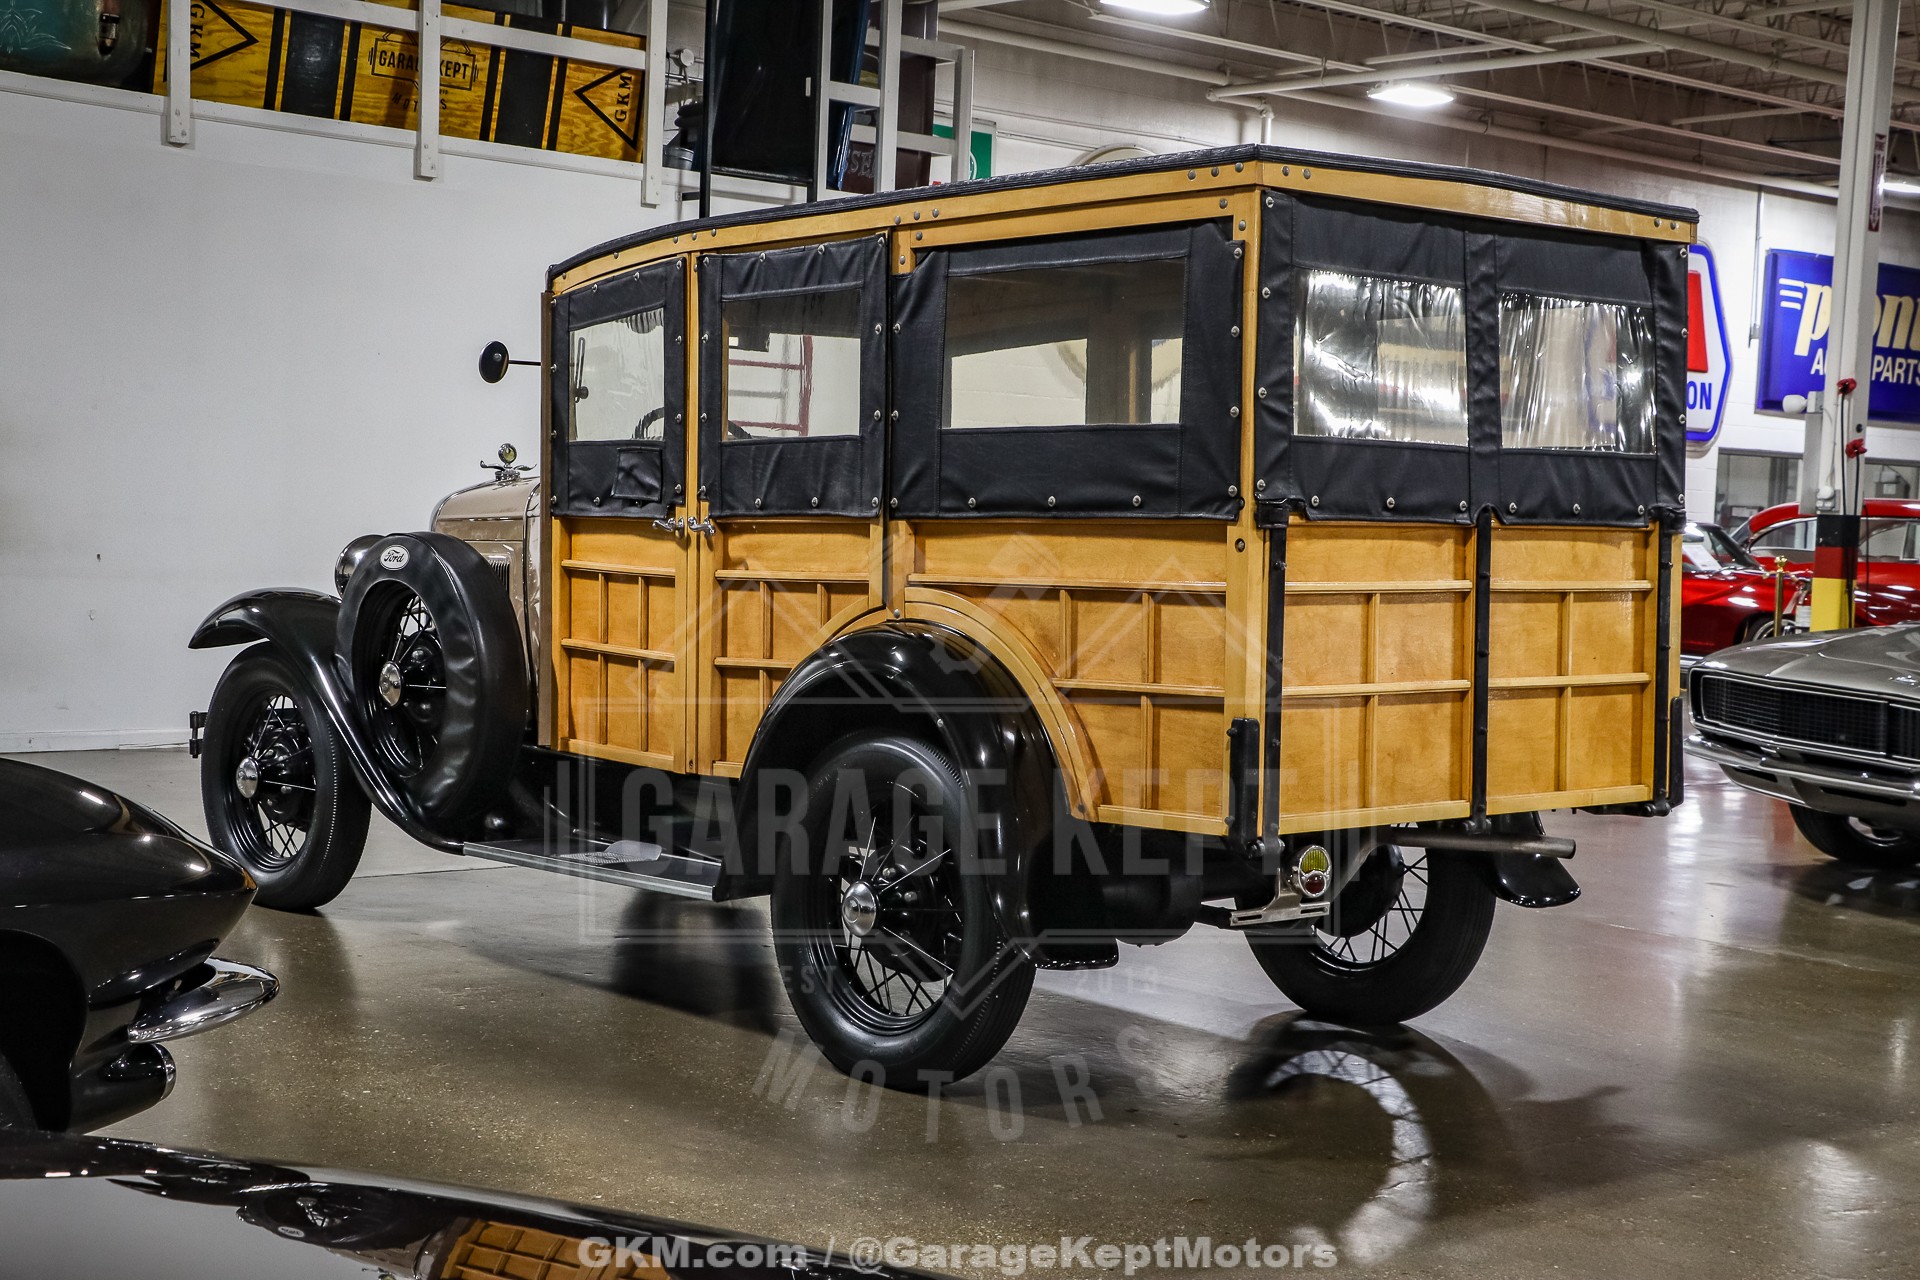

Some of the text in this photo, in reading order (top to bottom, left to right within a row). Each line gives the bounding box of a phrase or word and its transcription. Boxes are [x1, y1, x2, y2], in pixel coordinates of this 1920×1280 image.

[190, 3, 205, 59] GKM
[614, 75, 632, 122] GKM
[383, 549, 405, 563] Ford
